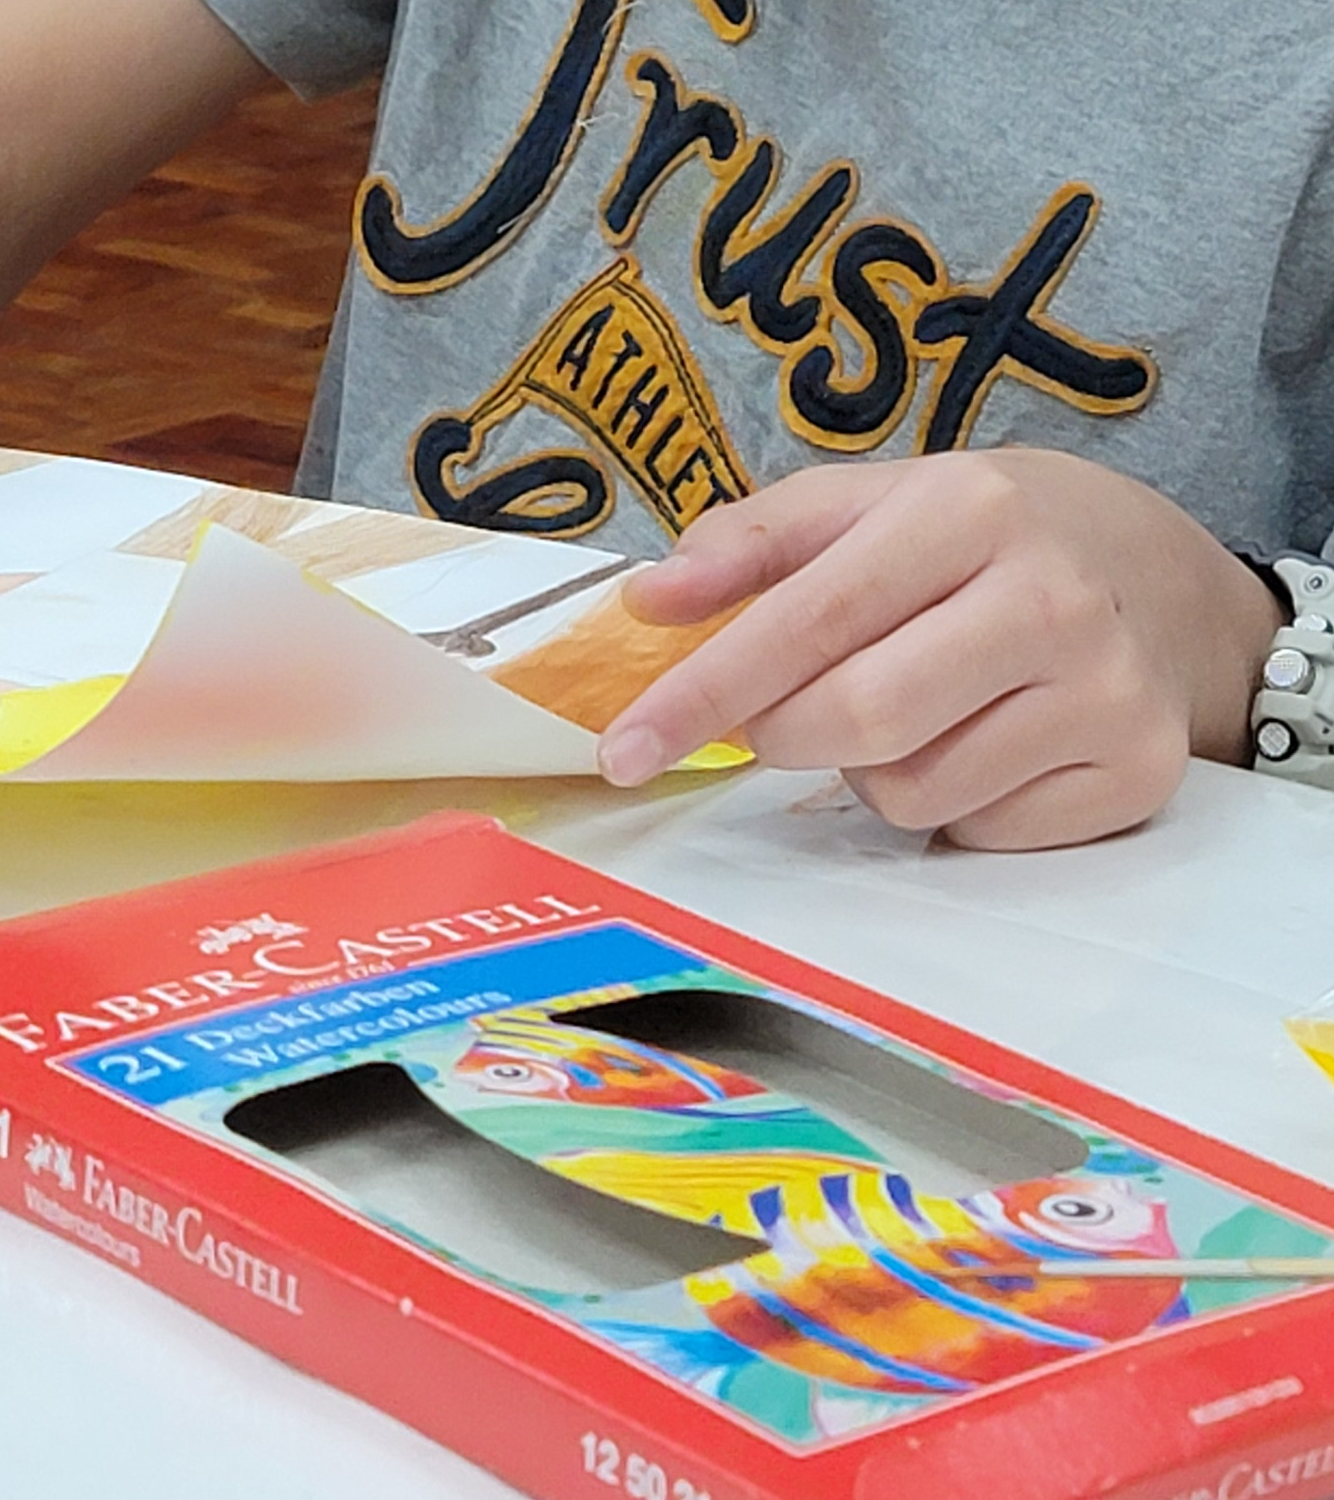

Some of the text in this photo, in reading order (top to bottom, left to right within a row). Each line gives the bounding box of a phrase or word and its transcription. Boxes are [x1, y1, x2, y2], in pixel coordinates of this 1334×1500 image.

[98, 979, 441, 1084] 21 Deckfarben
[221, 990, 513, 1068] Watercolours
[83, 1154, 304, 1315] FABER-CASTELL
[580, 1430, 620, 1486] 12
[624, 1452, 667, 1500] 50
